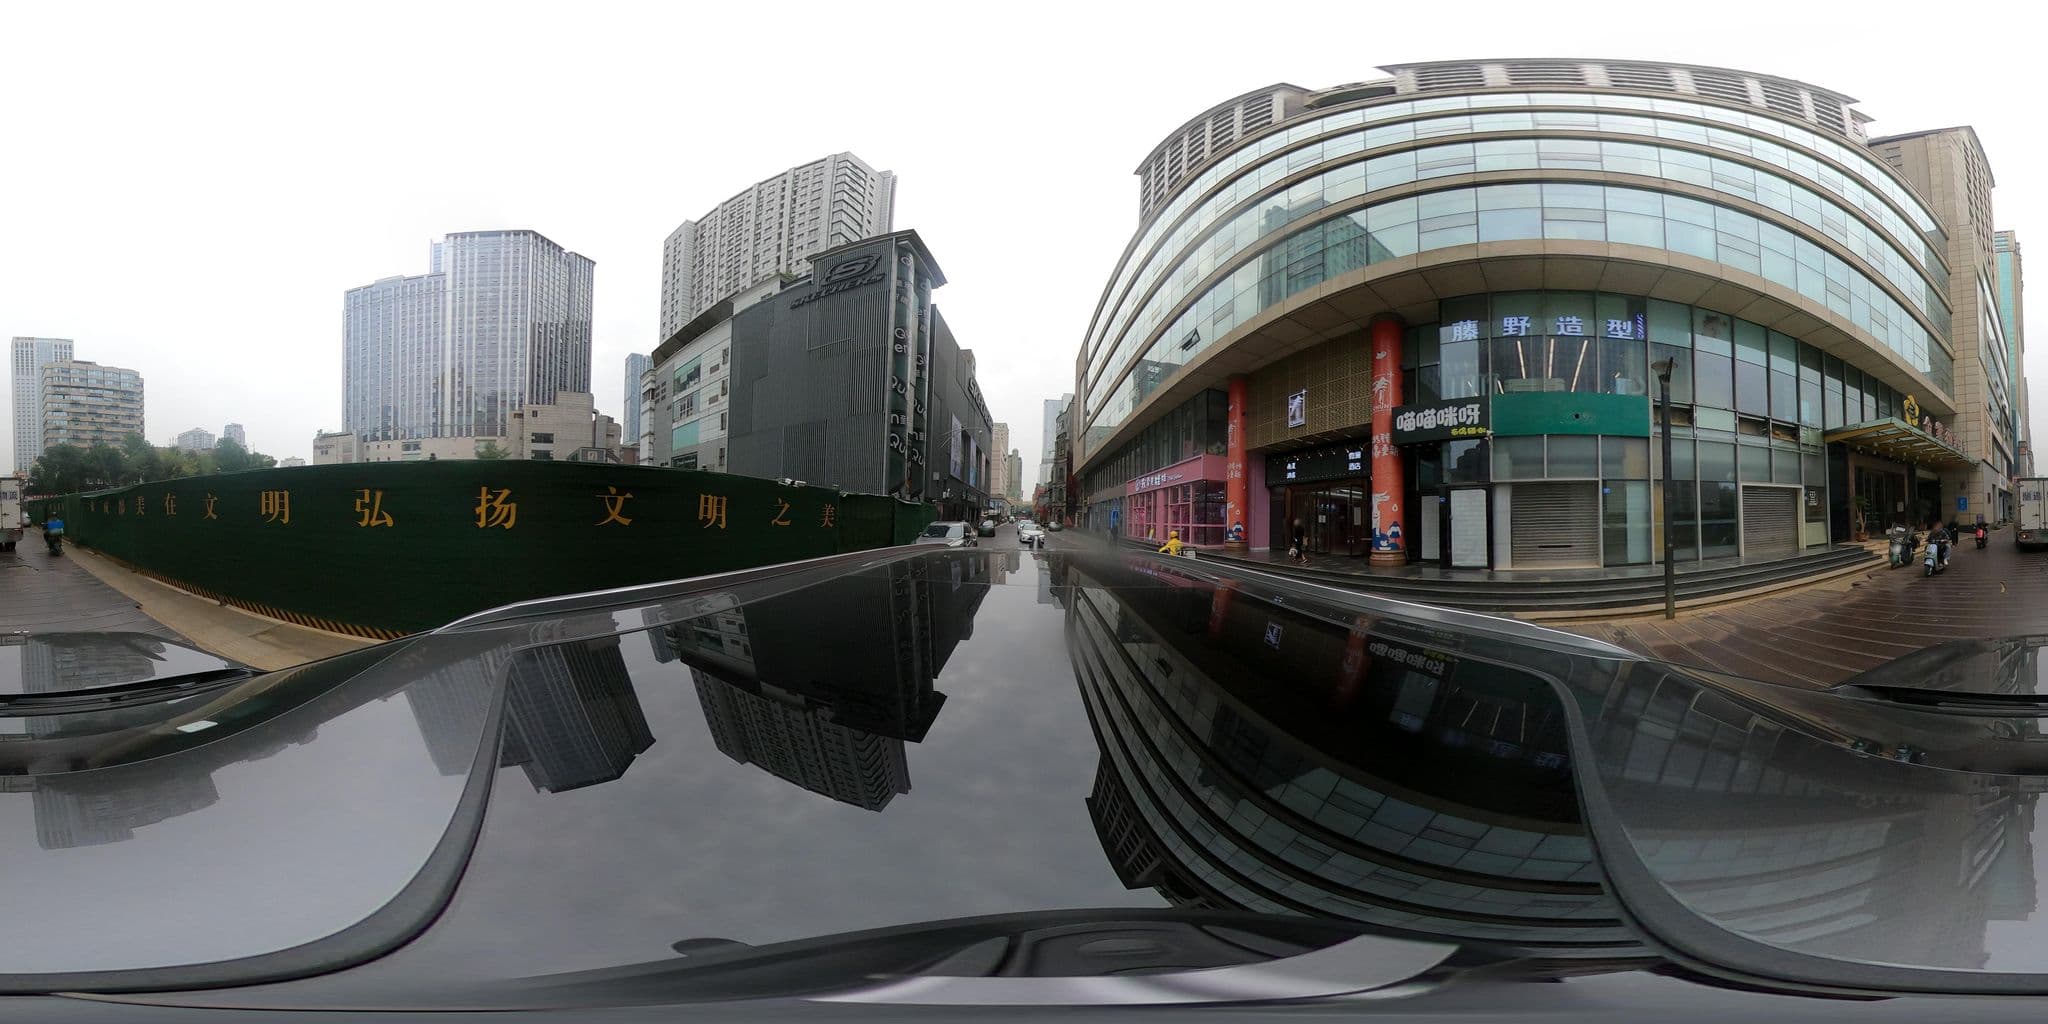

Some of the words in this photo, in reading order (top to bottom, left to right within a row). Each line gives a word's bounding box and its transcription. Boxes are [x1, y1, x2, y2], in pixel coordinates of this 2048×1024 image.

[1452, 314, 1634, 343] 藤野造型
[1397, 404, 1480, 431] 喵喵咪呀
